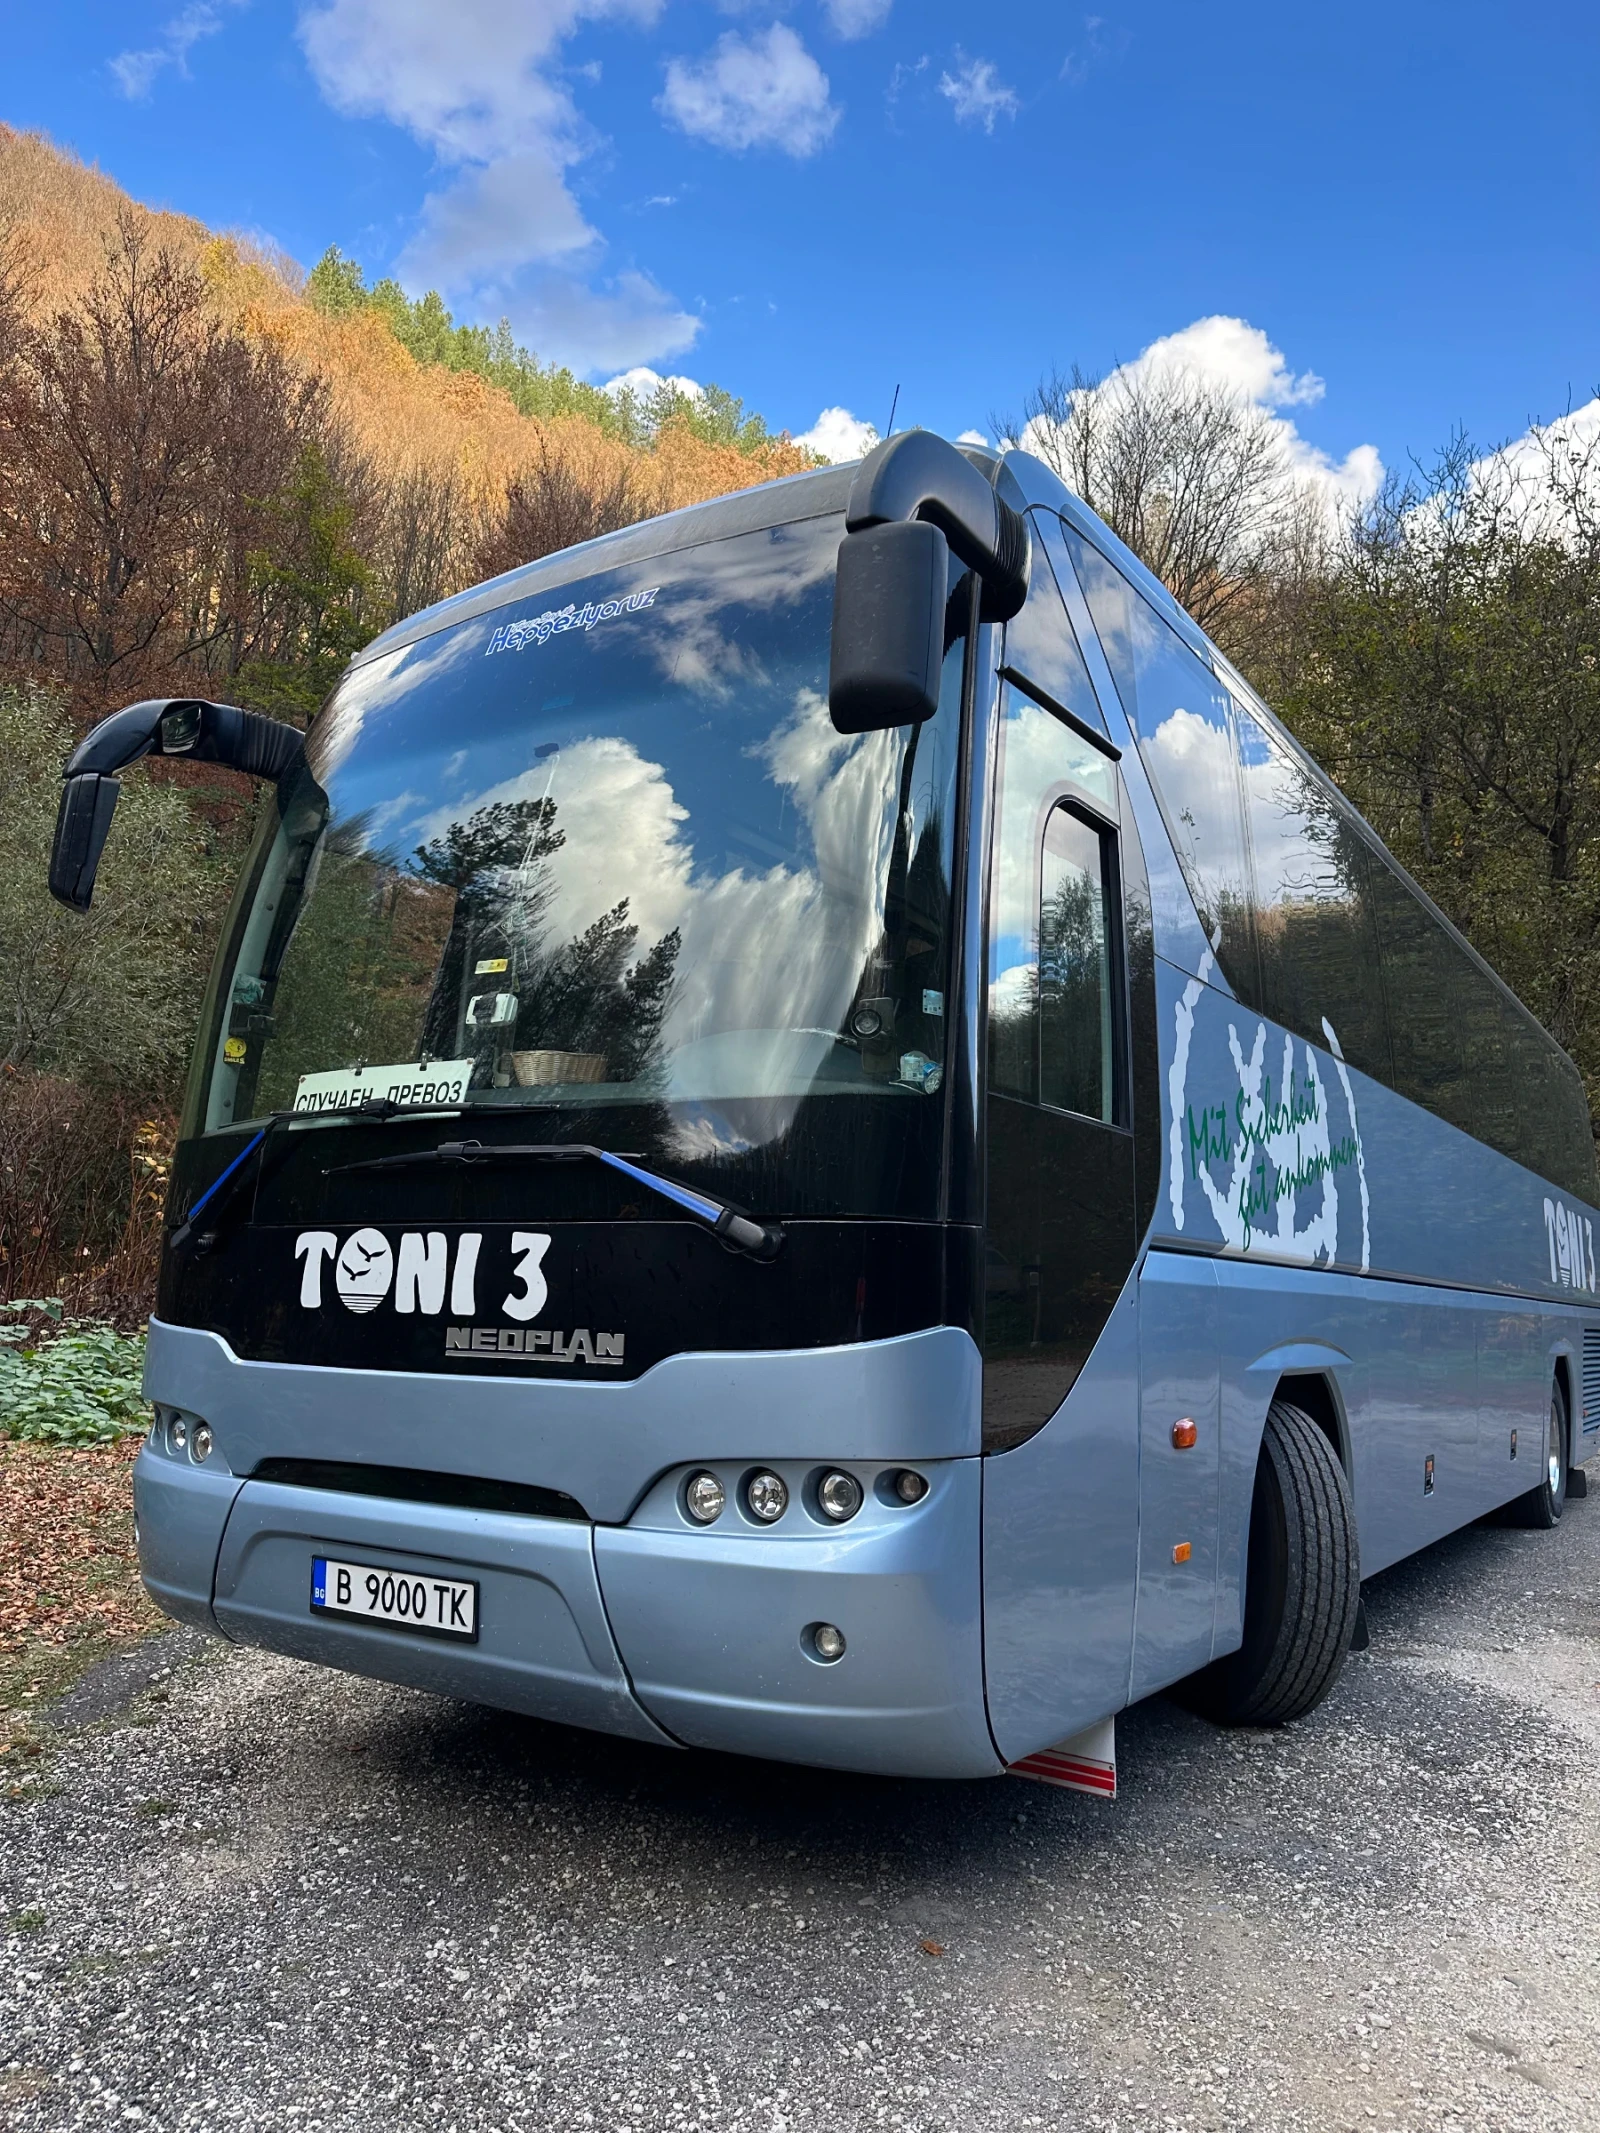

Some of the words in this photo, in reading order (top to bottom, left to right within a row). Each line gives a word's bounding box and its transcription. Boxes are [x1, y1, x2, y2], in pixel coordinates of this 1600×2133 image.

[485, 587, 660, 656] Hepgeziyoruz
[294, 1088, 374, 1111] СЛУЧАЕН
[387, 1081, 462, 1104] ПРЕВОЗ
[1188, 1101, 1231, 1179] Mit
[1236, 1069, 1320, 1162] Sicherheit
[1237, 1161, 1271, 1251] gut
[295, 1228, 483, 1316] TONI
[502, 1231, 552, 1321] 3
[1544, 1198, 1587, 1289] TONI
[1585, 1217, 1595, 1293] 3
[445, 1327, 625, 1364] NEOPLAN
[314, 1588, 325, 1599] BG
[337, 1568, 351, 1604] B
[366, 1574, 426, 1618] 9000
[434, 1585, 468, 1627] TK
